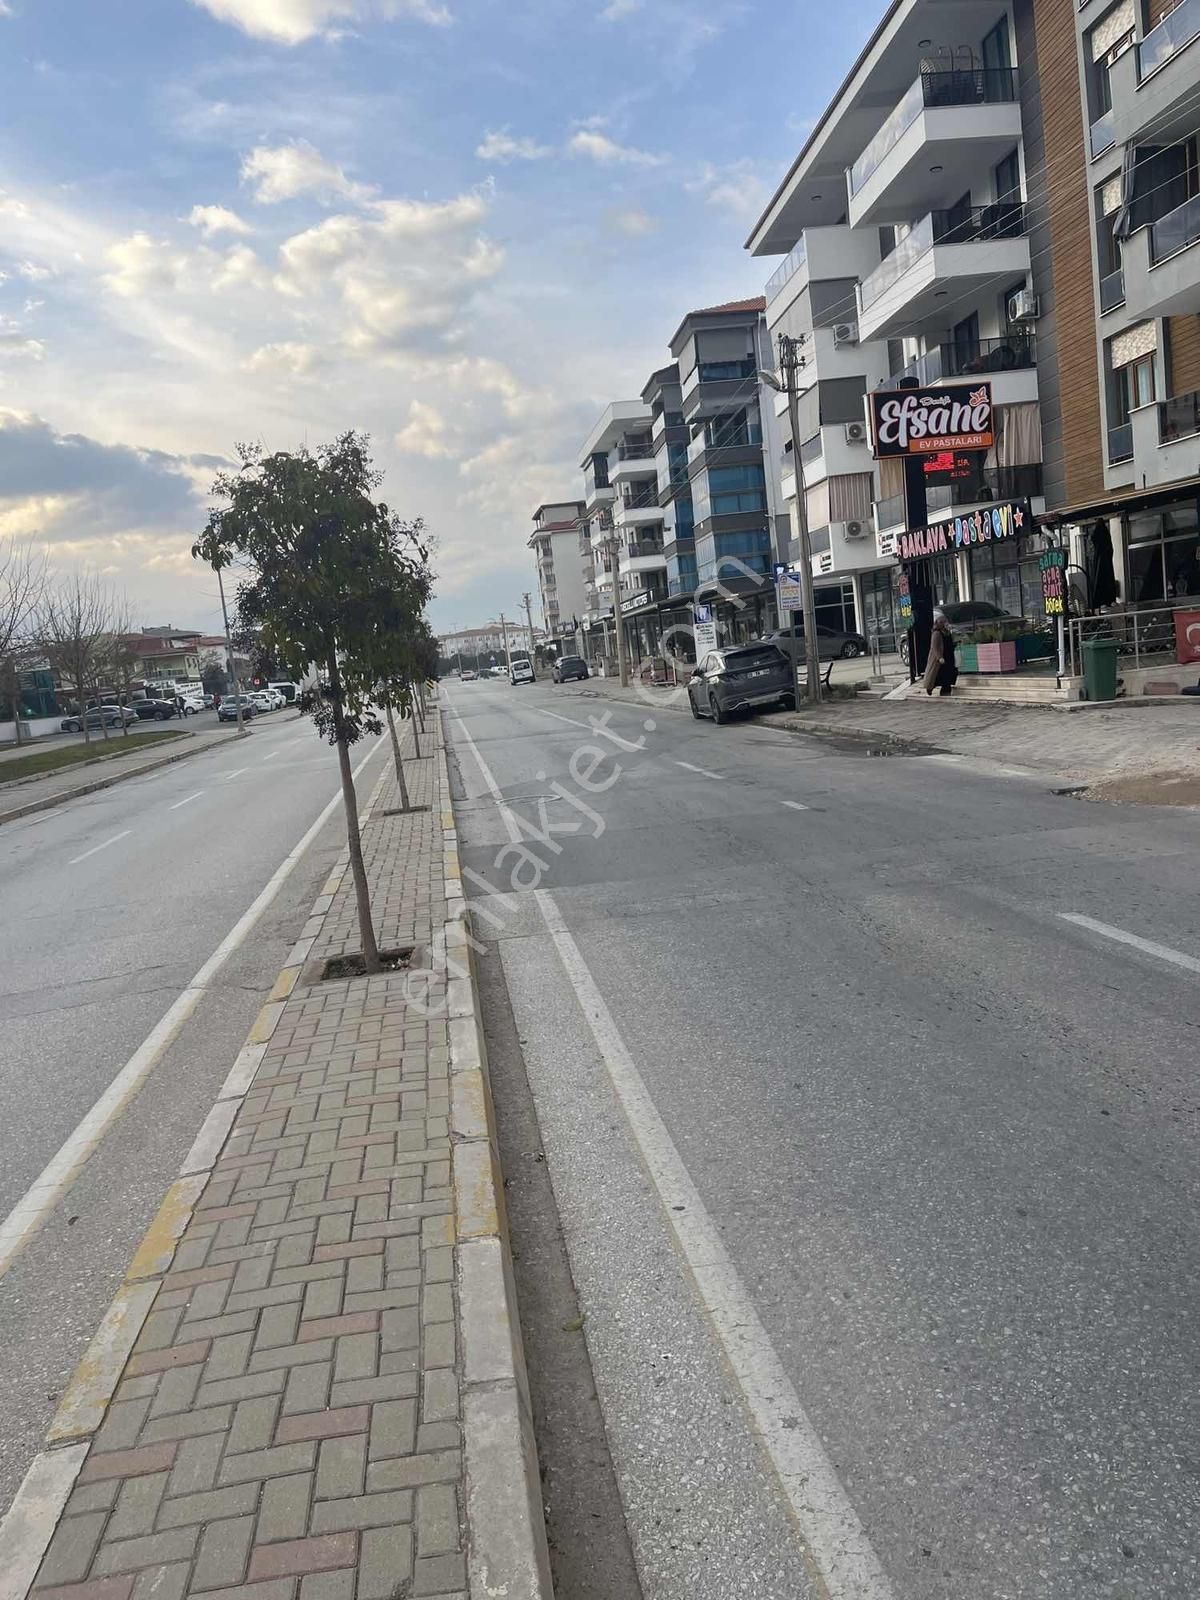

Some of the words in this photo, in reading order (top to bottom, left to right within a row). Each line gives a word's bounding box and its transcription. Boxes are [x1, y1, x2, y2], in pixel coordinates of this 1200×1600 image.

[879, 396, 990, 447] Efsane
[919, 440, 932, 449] EV
[933, 436, 983, 448] PASTALARI
[902, 524, 948, 559] BAKLAVA
